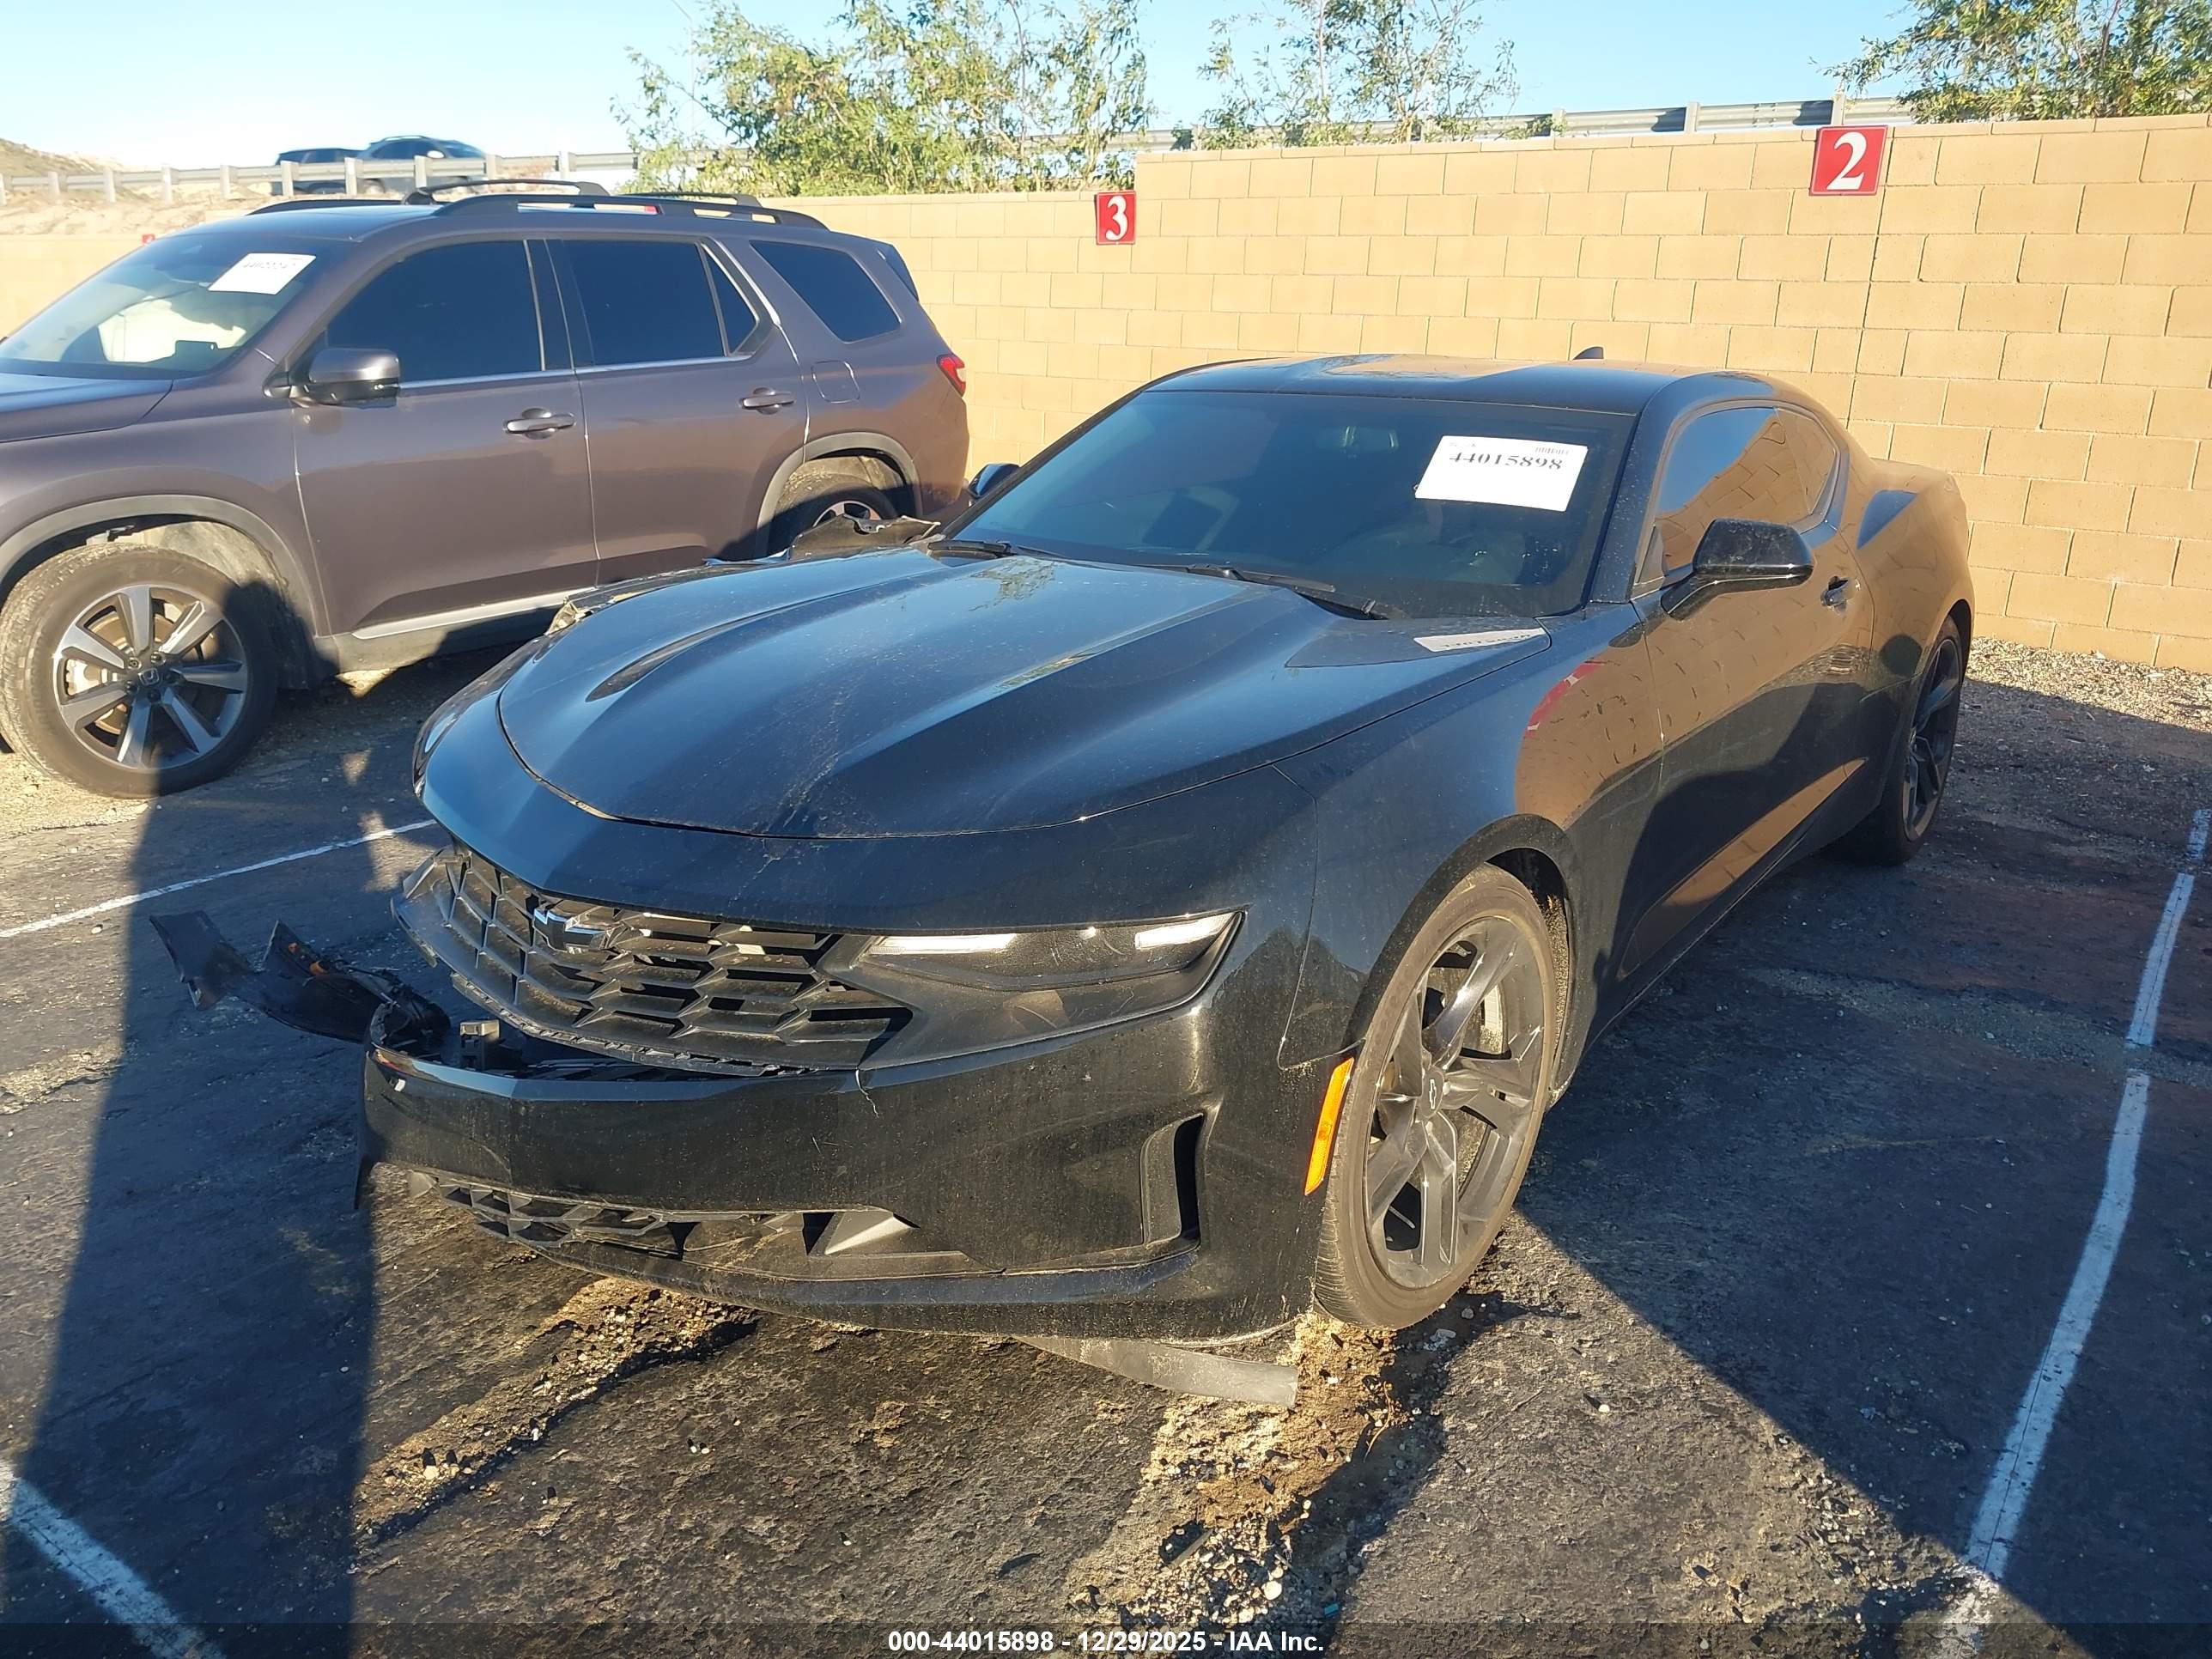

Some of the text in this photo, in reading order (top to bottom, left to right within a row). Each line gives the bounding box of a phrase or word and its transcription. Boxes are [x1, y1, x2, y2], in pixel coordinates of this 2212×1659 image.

[1826, 131, 1867, 190] 2
[1105, 195, 1128, 241] 3
[1449, 452, 1563, 470] 44015898
